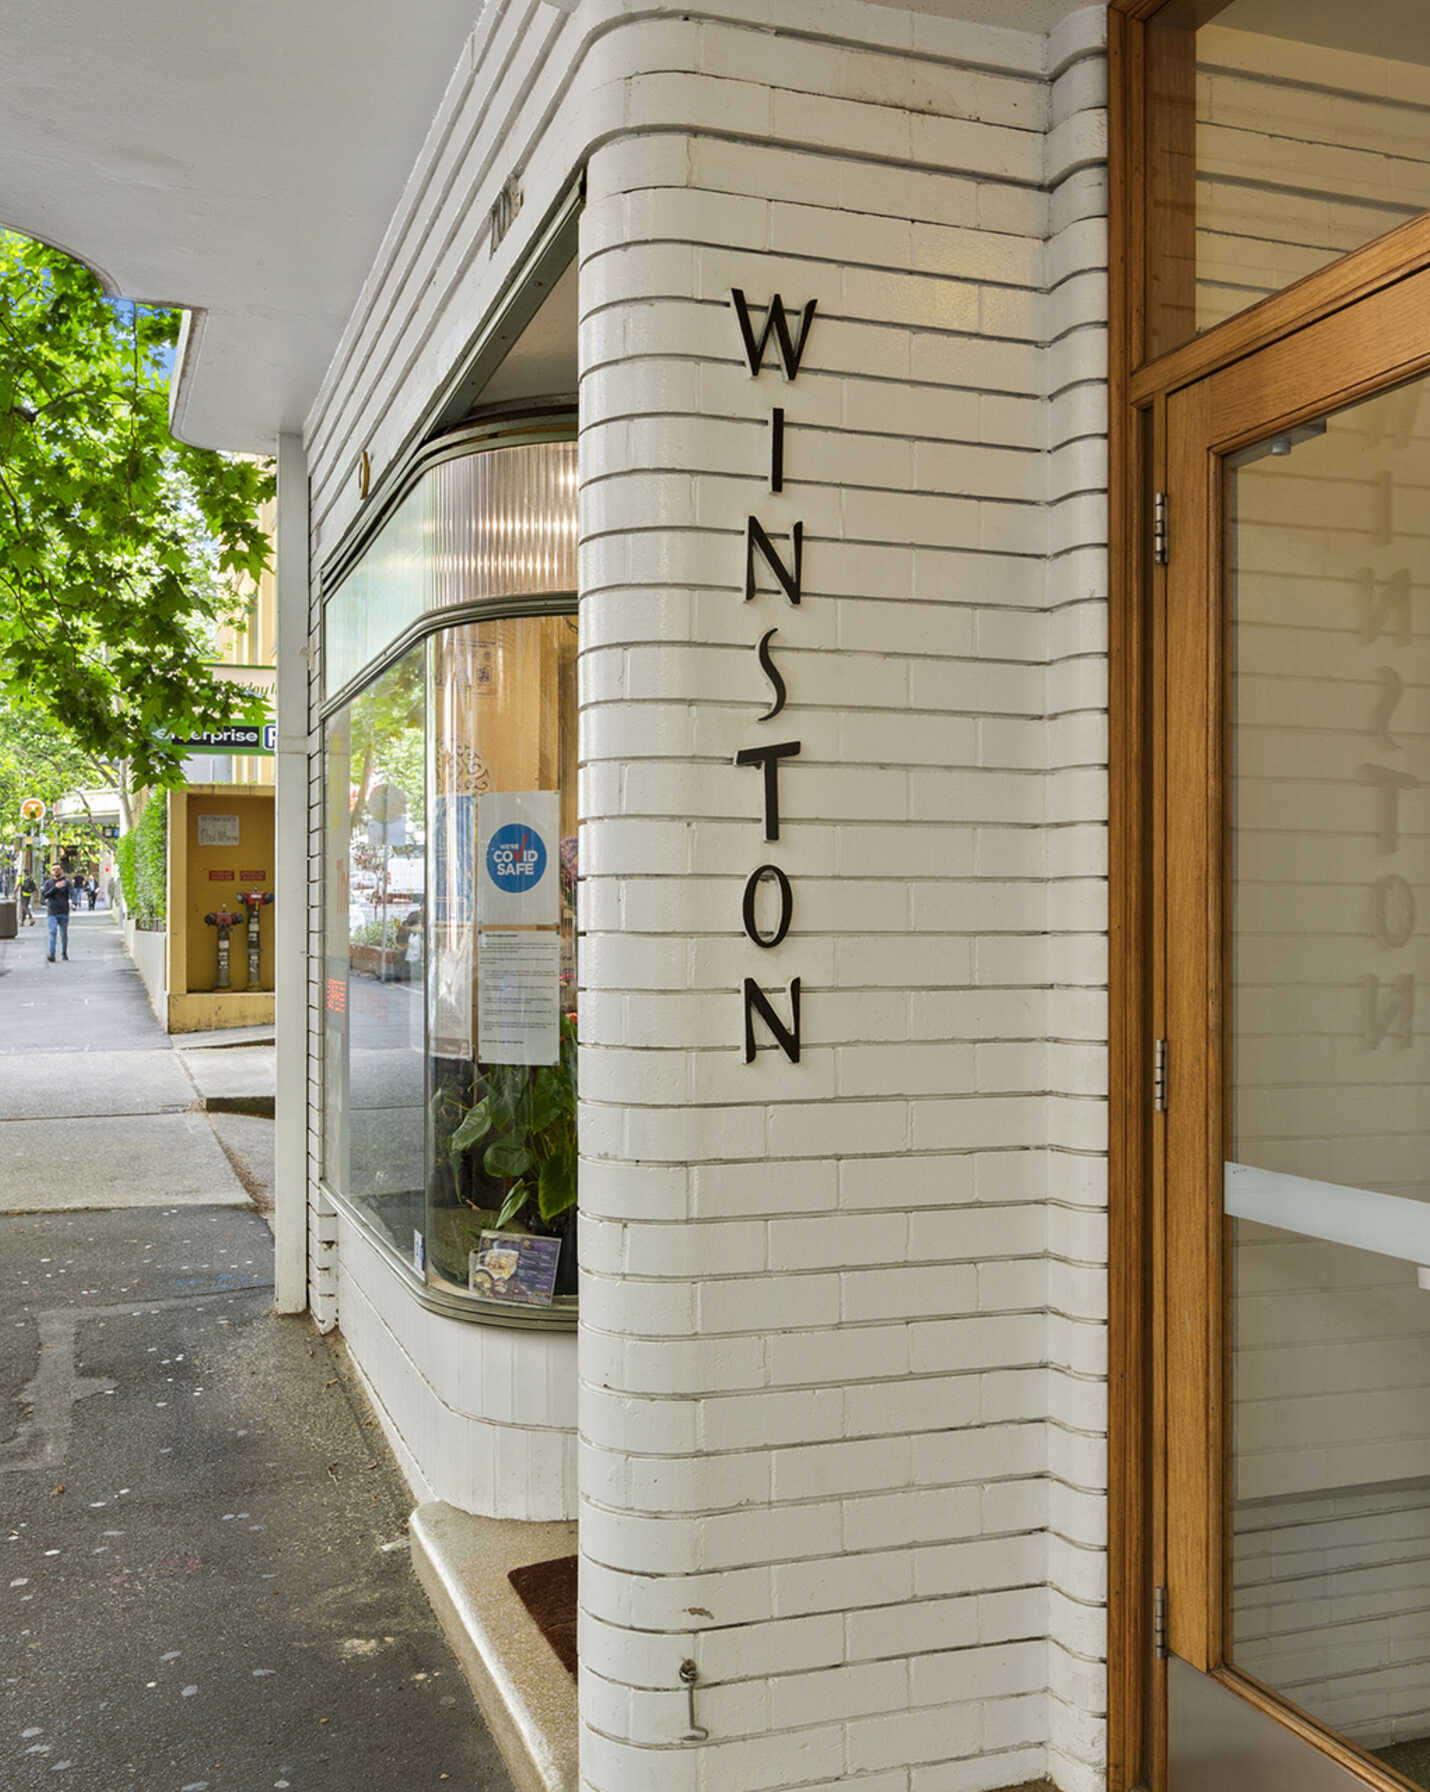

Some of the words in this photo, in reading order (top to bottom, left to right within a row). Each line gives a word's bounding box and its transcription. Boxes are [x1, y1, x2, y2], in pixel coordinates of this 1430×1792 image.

[729, 287, 817, 1065] WINSTON
[493, 848, 539, 863] COVID
[496, 862, 535, 876] SAFE
